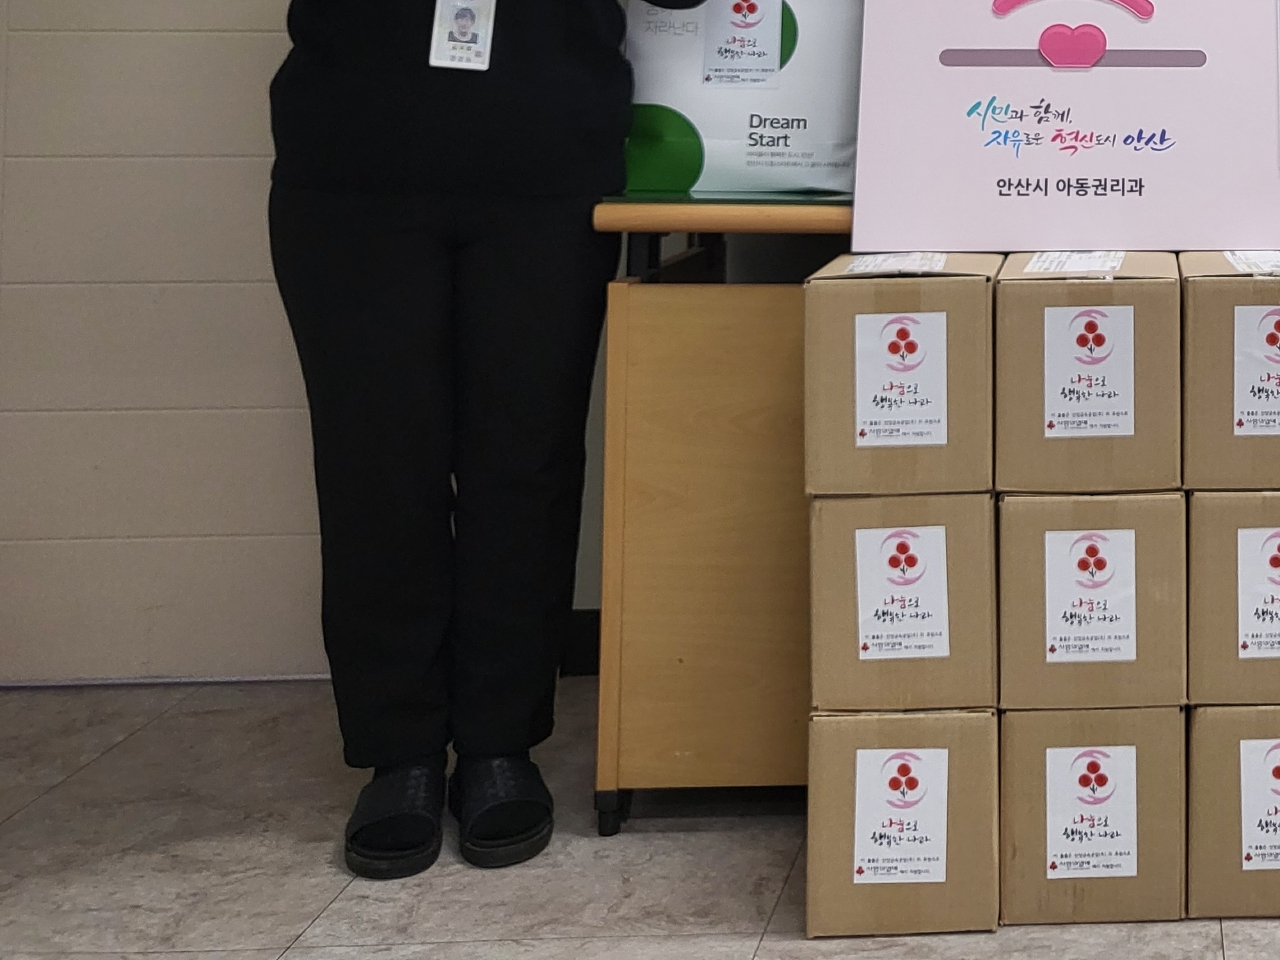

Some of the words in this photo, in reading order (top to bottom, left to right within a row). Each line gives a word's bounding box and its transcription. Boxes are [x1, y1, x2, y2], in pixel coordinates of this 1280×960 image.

[749, 113, 808, 130] Dream
[967, 96, 1029, 131] 시민과
[748, 132, 791, 147] Start
[984, 129, 1044, 158] 자유로운
[1050, 128, 1117, 157] 혁신도시
[1122, 129, 1177, 152] 안산
[997, 178, 1048, 196] 안산시
[1056, 178, 1145, 196] 아동권리과
